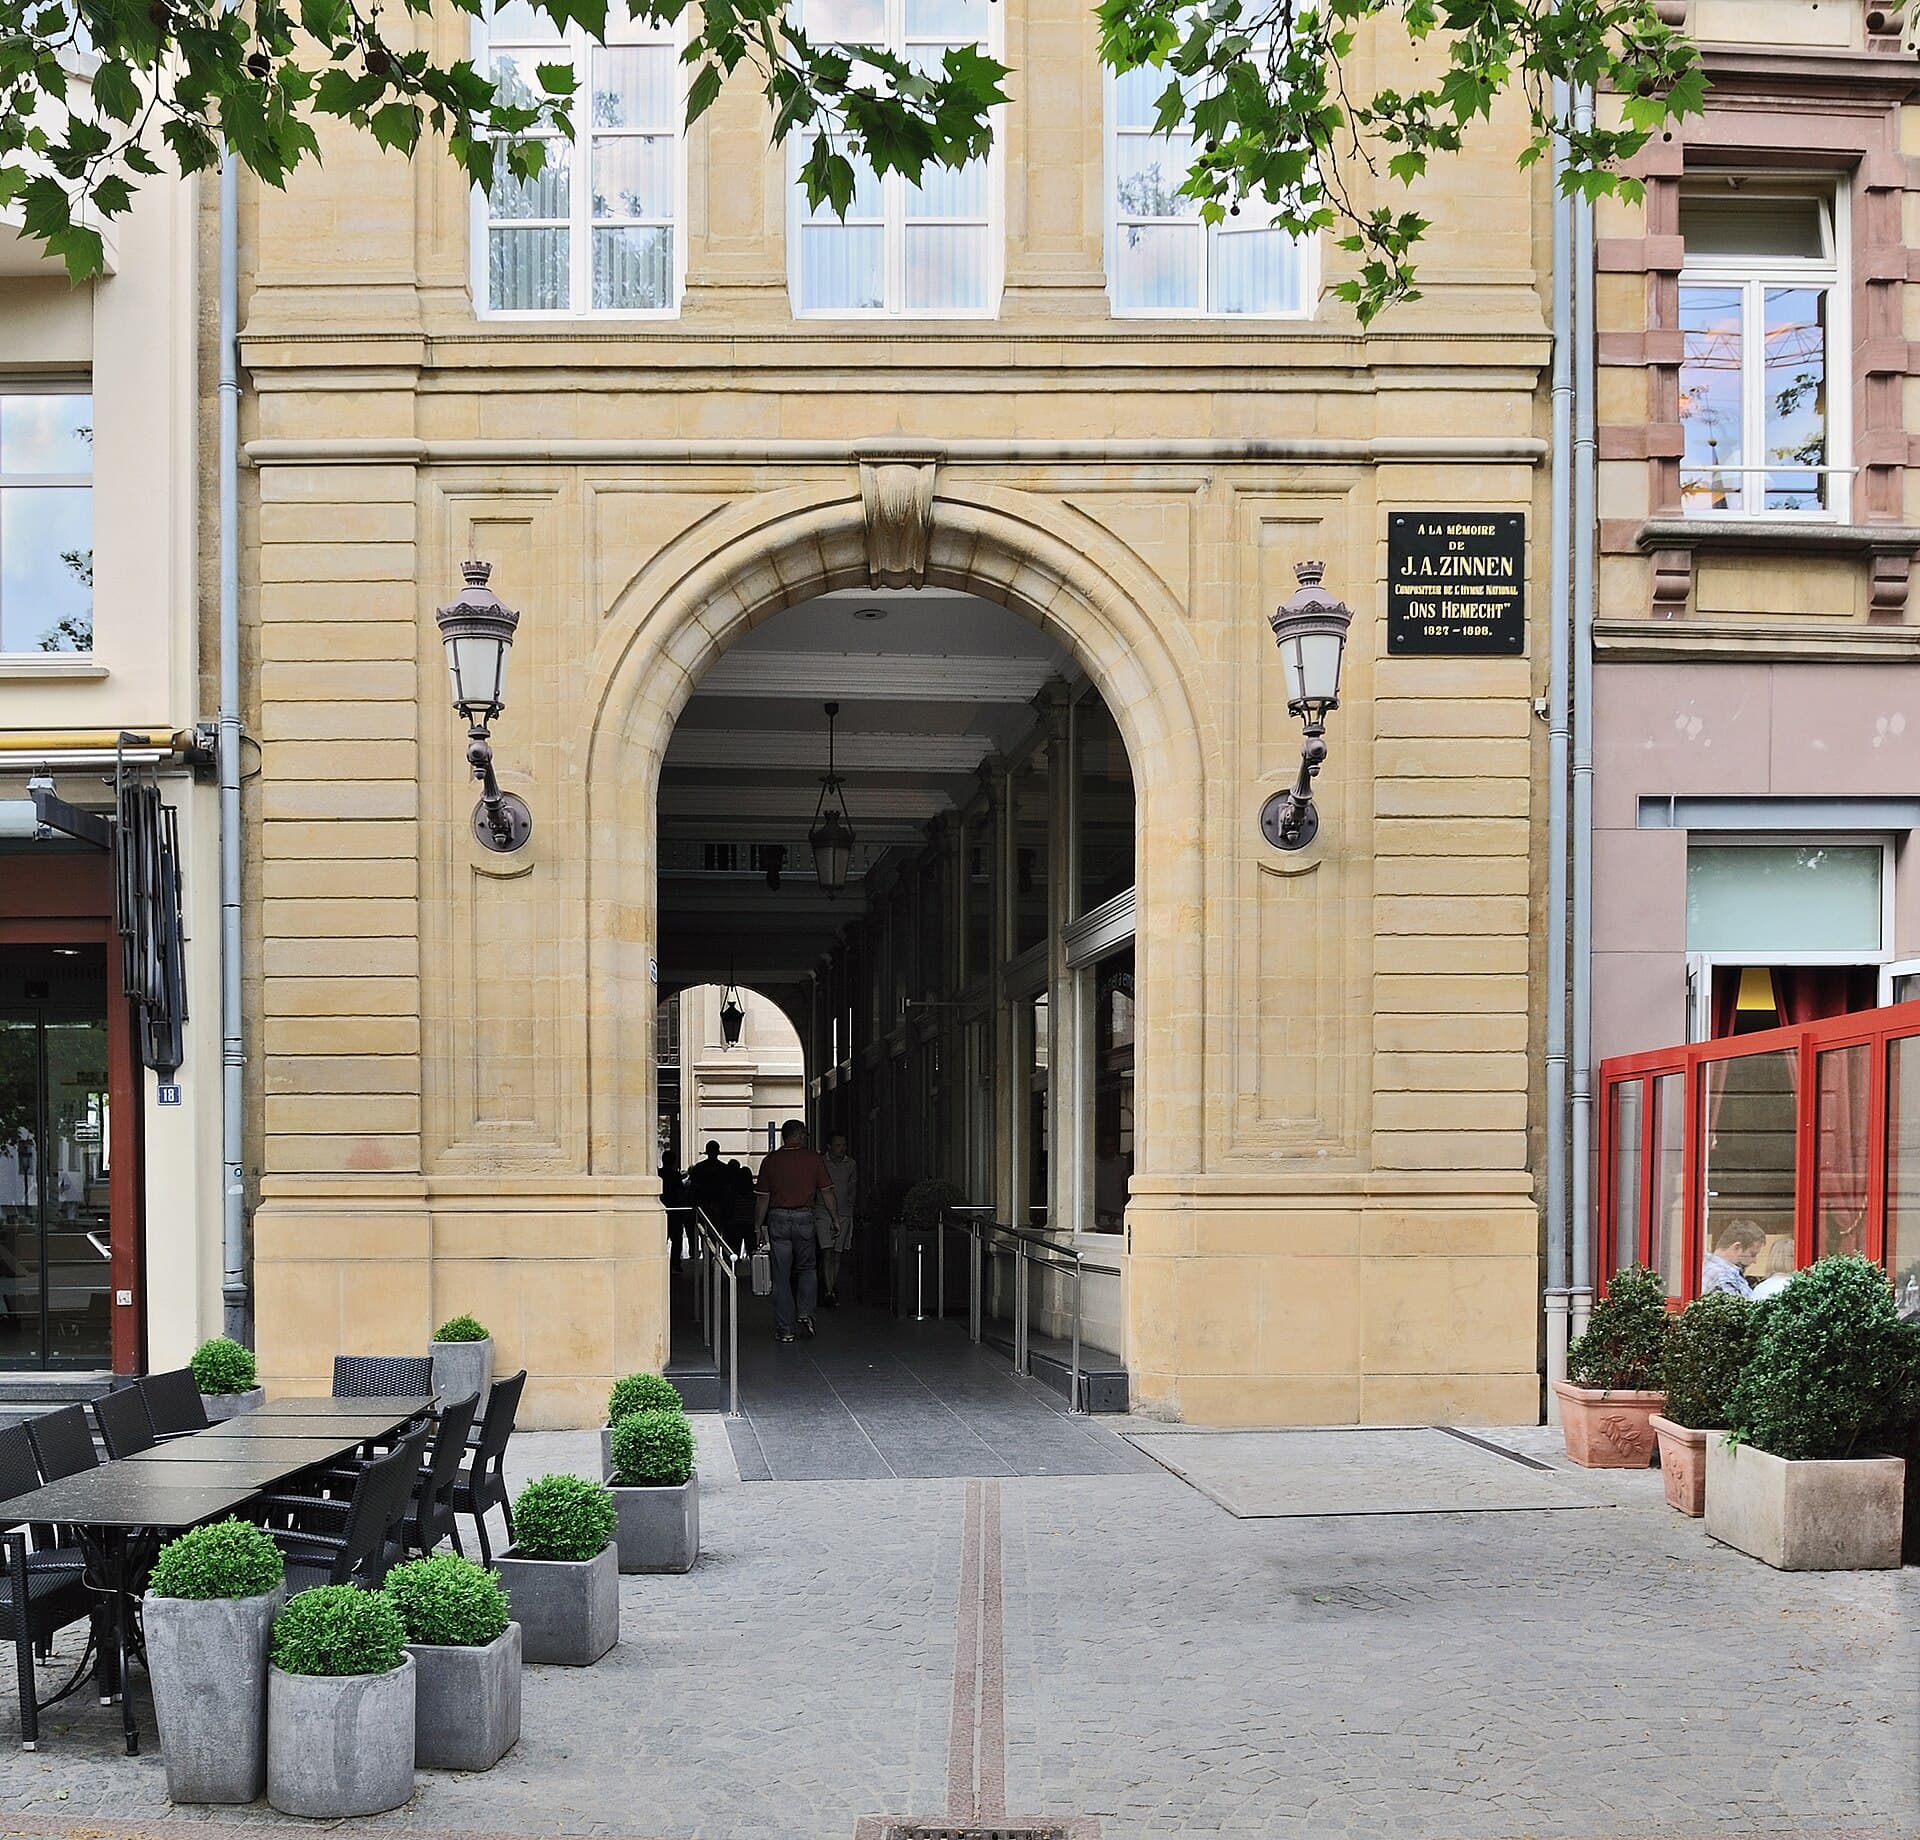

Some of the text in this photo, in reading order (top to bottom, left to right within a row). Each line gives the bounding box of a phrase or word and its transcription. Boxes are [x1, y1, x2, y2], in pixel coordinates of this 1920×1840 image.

[1429, 525, 1442, 535] LA
[1447, 524, 1495, 535] MÉMOIRE
[1449, 542, 1464, 550] DE
[1444, 586, 1453, 595] DE
[1486, 585, 1518, 595] NATIONAL
[1424, 626, 1449, 635] 1827
[164, 1089, 174, 1101] 18
